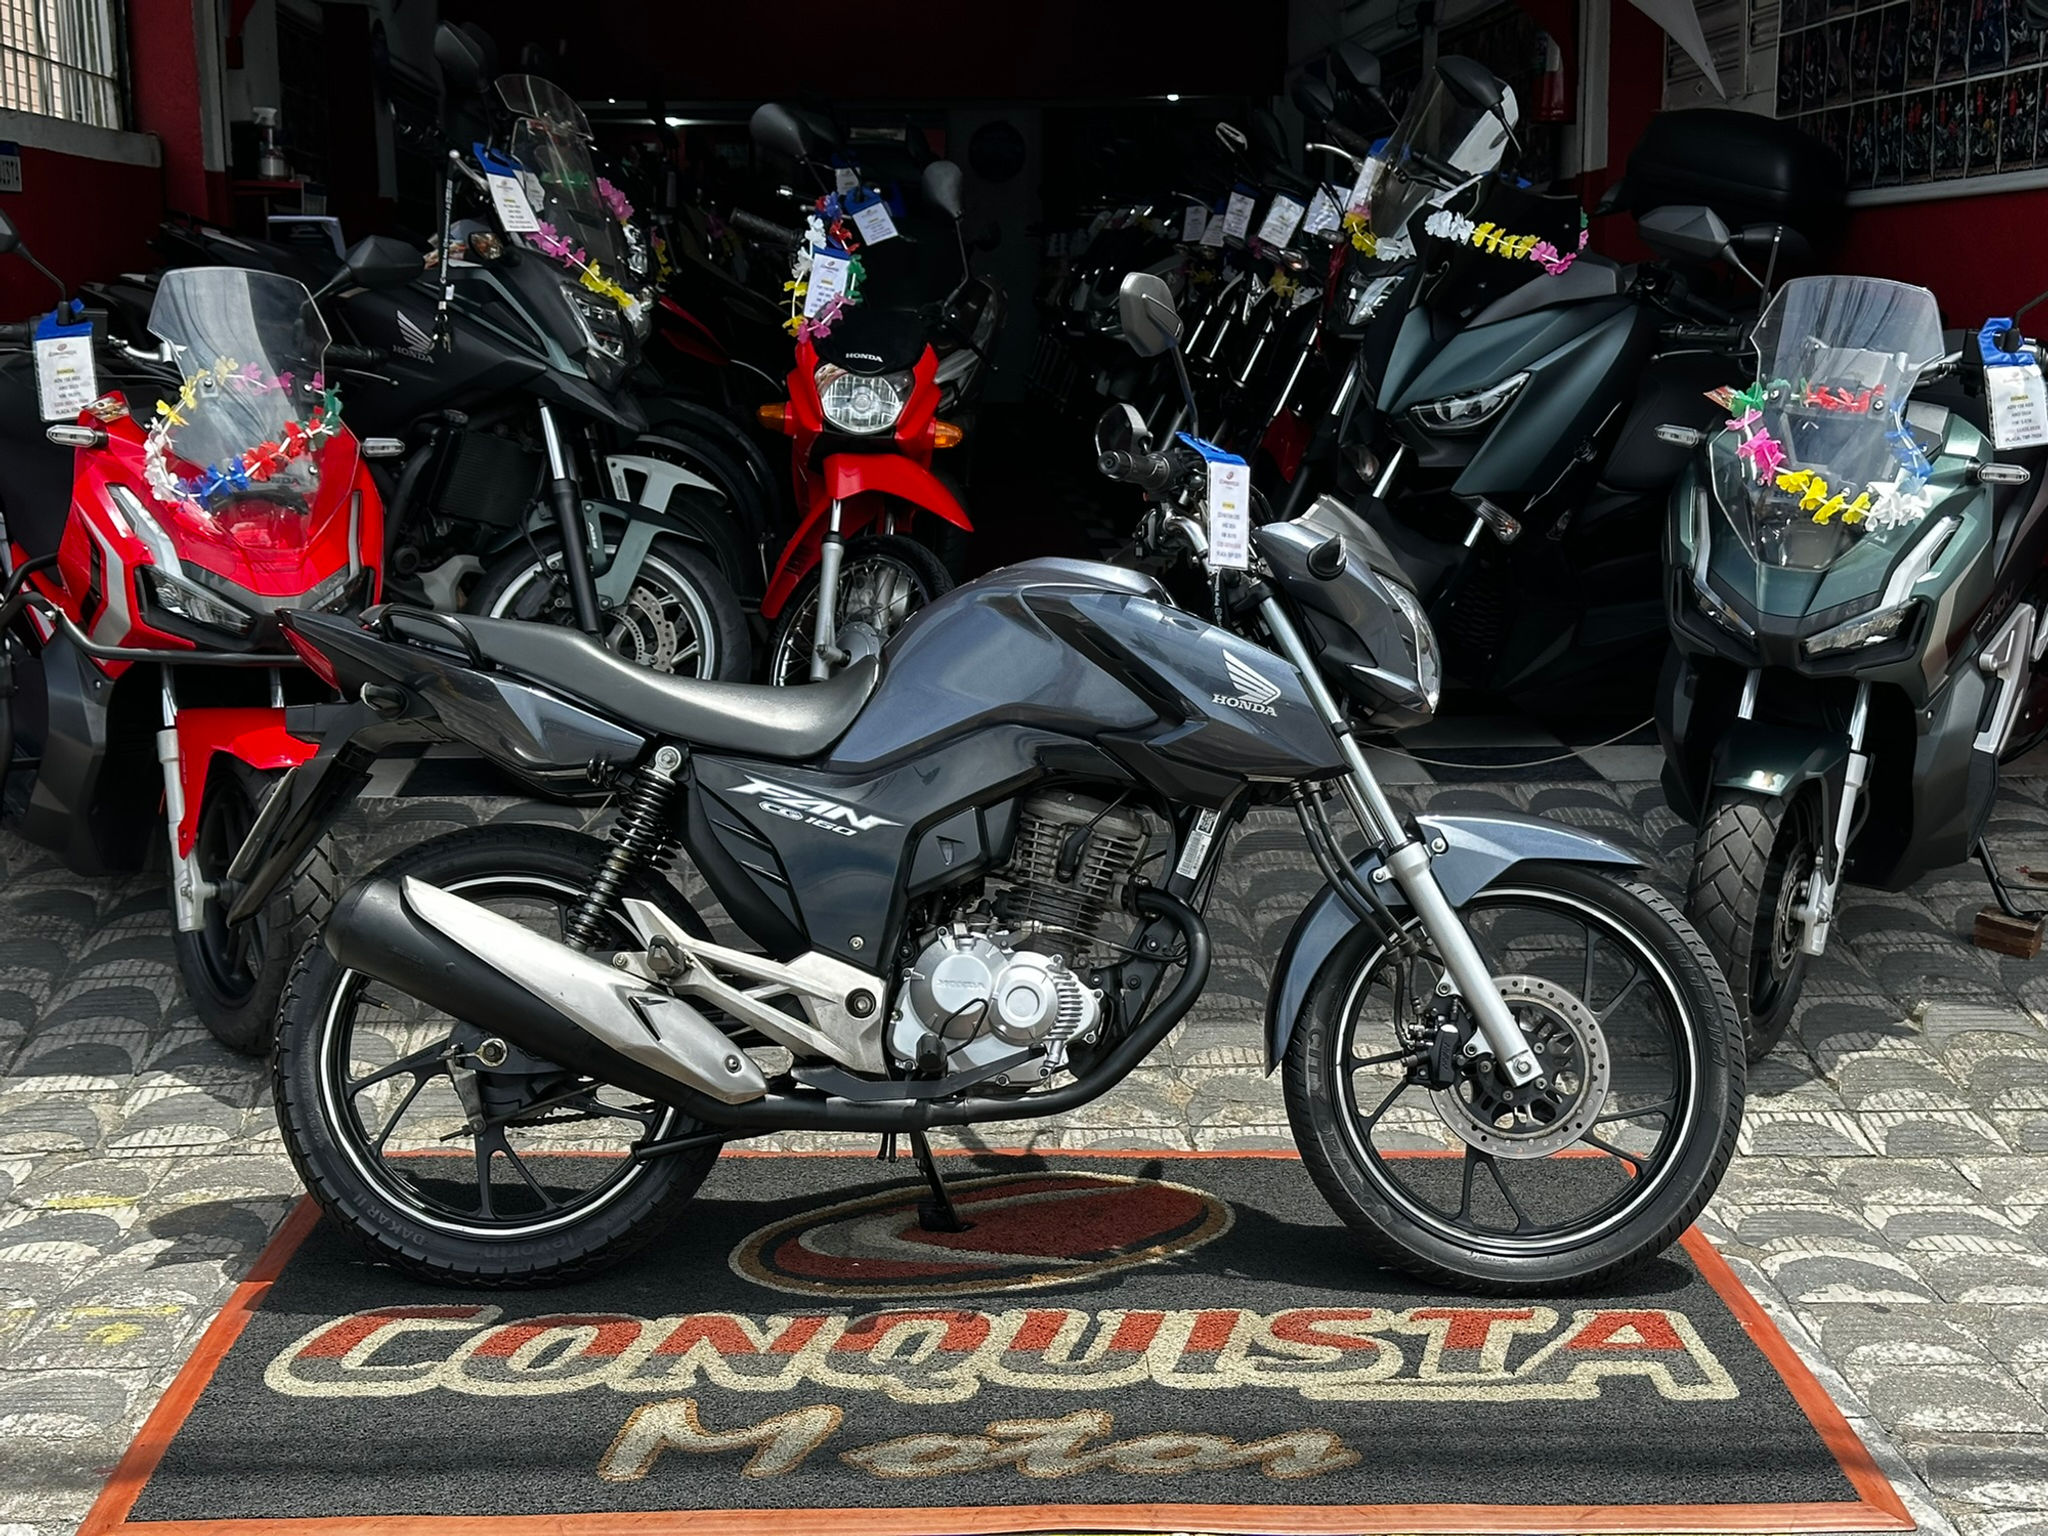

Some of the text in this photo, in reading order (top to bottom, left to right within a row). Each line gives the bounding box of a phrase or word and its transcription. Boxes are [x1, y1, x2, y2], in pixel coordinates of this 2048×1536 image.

[392, 344, 434, 364] HONDA
[845, 352, 884, 363] HONDA
[1211, 693, 1278, 718] HONDA
[804, 817, 857, 837] 160
[1304, 1029, 1329, 1105] CITY
[366, 1205, 426, 1246] DAKAR
[263, 1303, 1740, 1402] CONQUISTA
